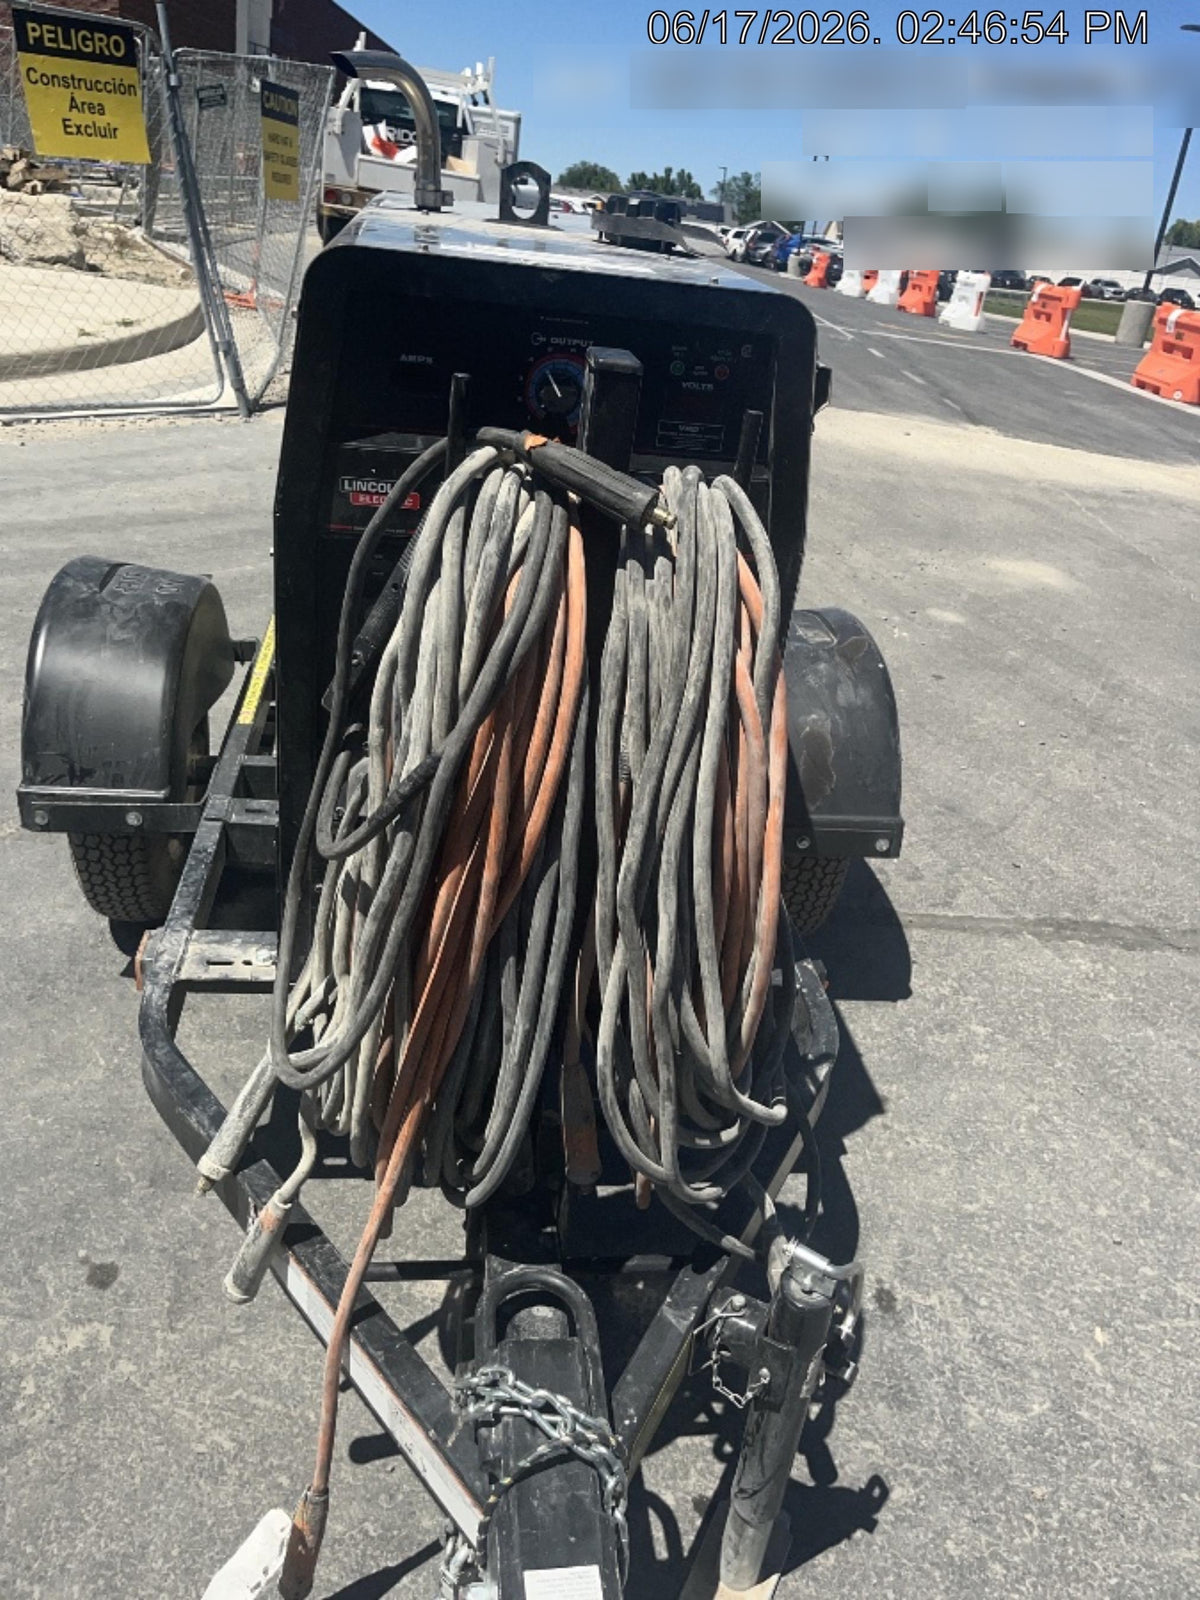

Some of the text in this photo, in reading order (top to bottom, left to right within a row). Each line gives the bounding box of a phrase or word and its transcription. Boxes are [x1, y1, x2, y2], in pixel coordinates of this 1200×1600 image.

[26, 21, 126, 58] PELIGRO
[25, 67, 137, 97] Construcción
[69, 92, 106, 116] Área
[62, 118, 119, 140] Excluir
[344, 479, 396, 493] LINCOL
